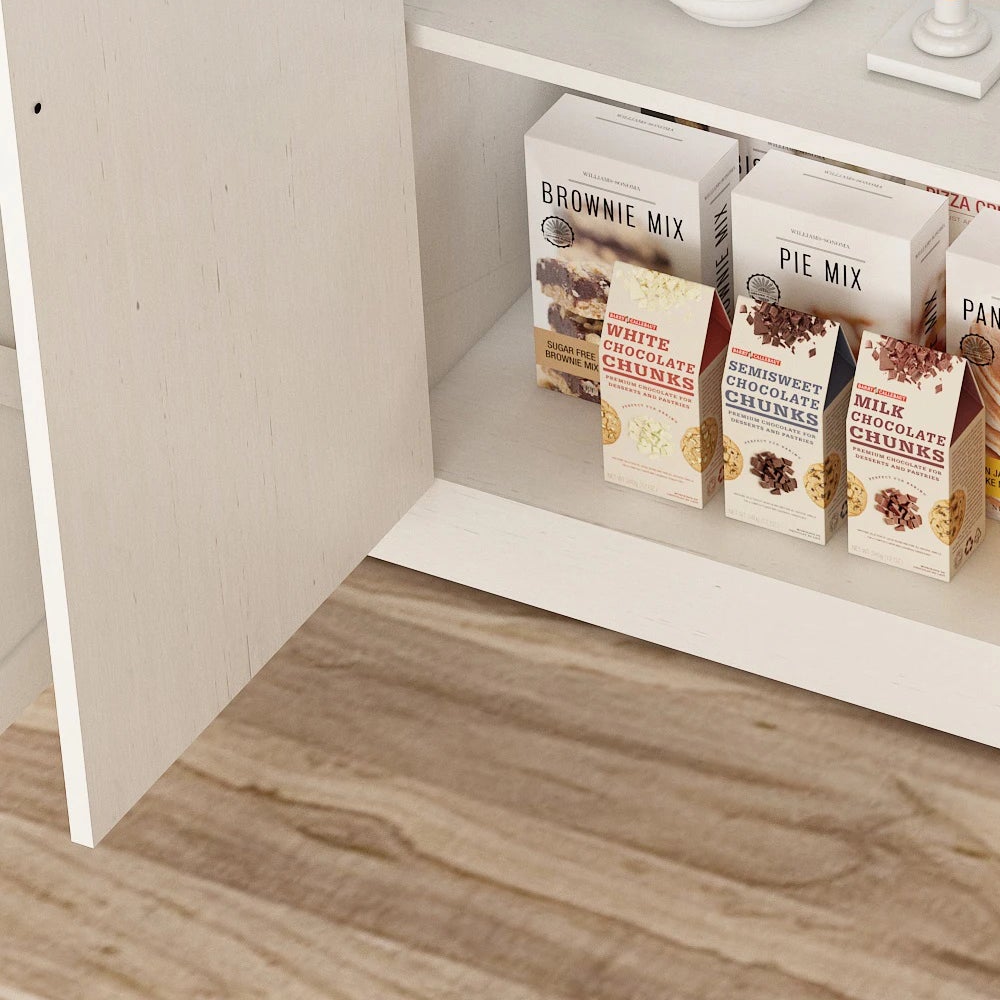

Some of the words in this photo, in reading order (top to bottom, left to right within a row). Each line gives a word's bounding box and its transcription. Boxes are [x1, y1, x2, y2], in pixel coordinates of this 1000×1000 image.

[582, 170, 641, 191] WILLIAMS-SONOMA
[541, 181, 635, 228] BROWNIE
[648, 210, 684, 242] MIX
[790, 228, 851, 250] WILLIAMS-SONOMA
[780, 247, 813, 278] PIE
[825, 259, 862, 291] MIX
[547, 340, 574, 355] SUGAR
[576, 348, 596, 362] FREE
[606, 322, 670, 352] WHITE
[545, 350, 582, 367] BROWNIE
[584, 360, 599, 372] MIX
[602, 354, 694, 390] CHUNKS
[603, 340, 696, 374] CHOCOLATE
[605, 374, 637, 386] PREMIUM
[638, 384, 678, 400] CHOCOLATE
[680, 396, 692, 404] FOR
[728, 360, 822, 395] SEMISWEET
[608, 382, 641, 395] DESSERTS
[643, 392, 657, 400] AND
[658, 396, 690, 409] PASTRIES
[724, 390, 818, 426] CHUNKS
[726, 375, 820, 411] CHOCOLATE
[854, 393, 905, 419] MILK
[728, 410, 760, 423] PREMIUM
[761, 419, 800, 435] CHOCOLATE
[730, 418, 764, 431] DESSERTS
[766, 428, 780, 436] AND
[781, 432, 814, 446] PASTRIES
[851, 410, 946, 447] CHOCOLATE
[850, 426, 944, 463] CHUNKS
[852, 446, 885, 459] PREMIUM
[886, 455, 927, 472] CHOCOLATE
[928, 468, 942, 476] FOR
[855, 454, 889, 467] DESSERTS
[890, 464, 906, 472] AND
[906, 468, 940, 482] PASTRIES
